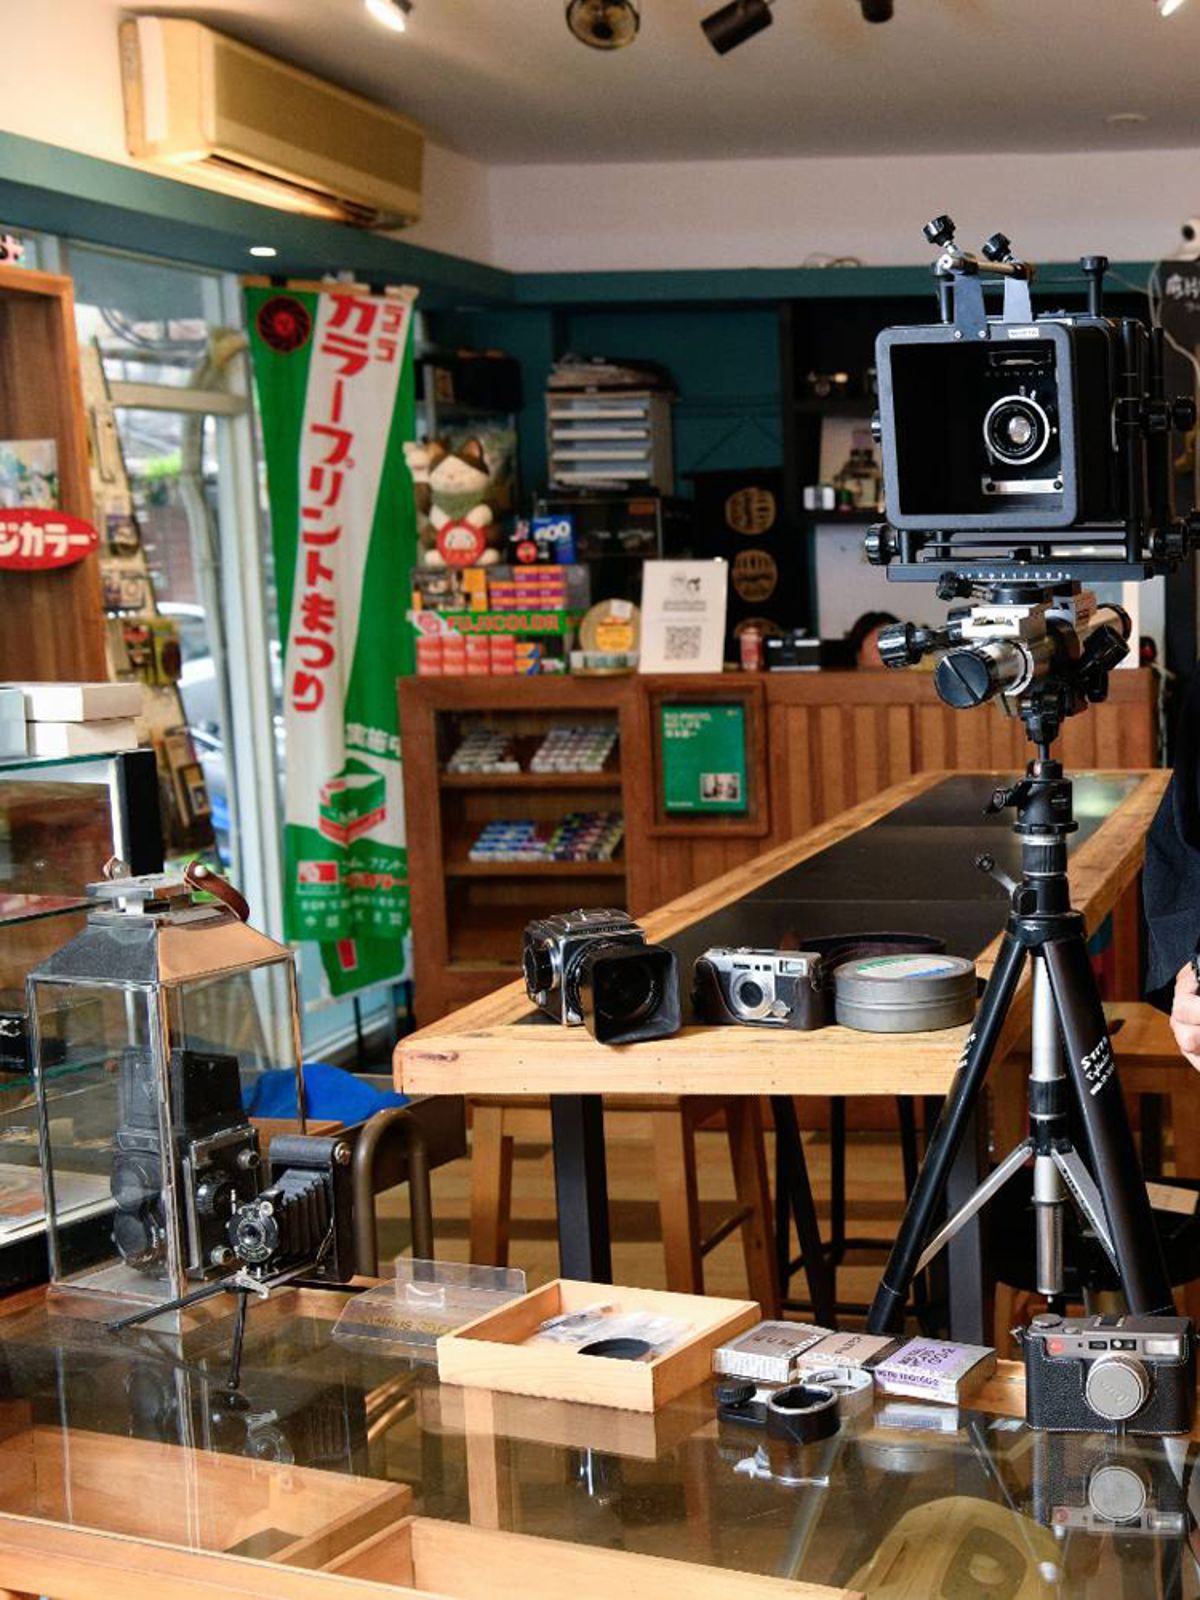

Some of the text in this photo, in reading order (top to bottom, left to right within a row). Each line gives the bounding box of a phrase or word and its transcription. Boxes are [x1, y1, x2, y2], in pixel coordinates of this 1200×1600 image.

[292, 292, 378, 713] カラープリントまつり
[446, 614, 559, 632] FUJICOLOR
